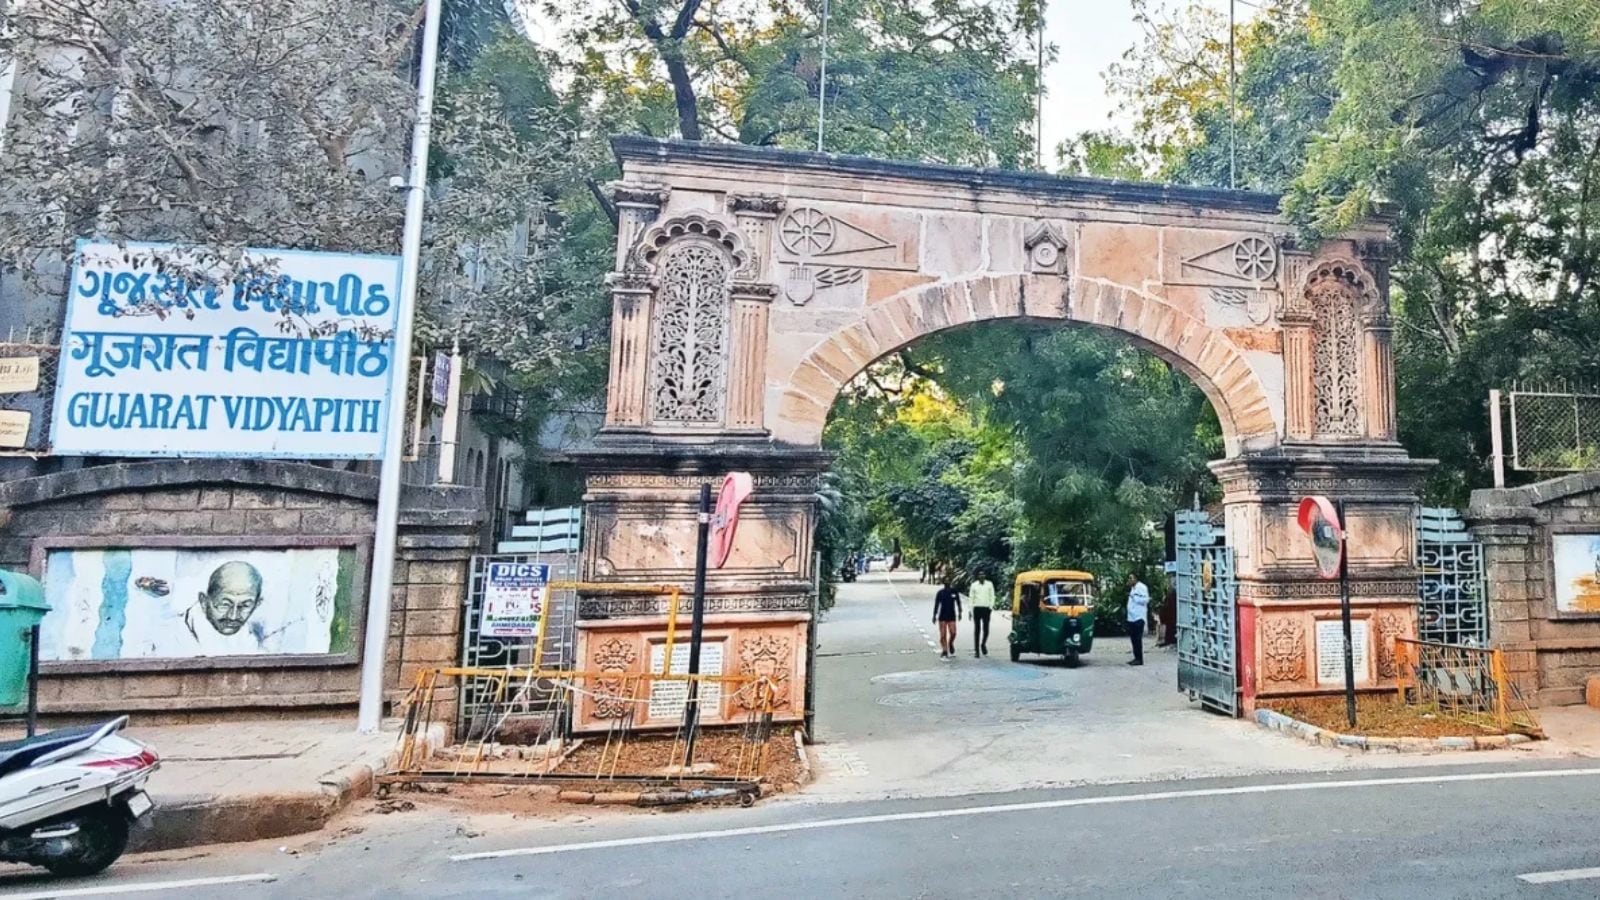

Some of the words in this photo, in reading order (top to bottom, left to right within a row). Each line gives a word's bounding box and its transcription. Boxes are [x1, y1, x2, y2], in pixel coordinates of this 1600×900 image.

[71, 331, 214, 378] गूजरात
[219, 326, 389, 378] विद्यापीठ
[67, 392, 217, 430] GUJARAT
[220, 395, 381, 433] VIDYAPITH
[497, 565, 542, 577] DICS
